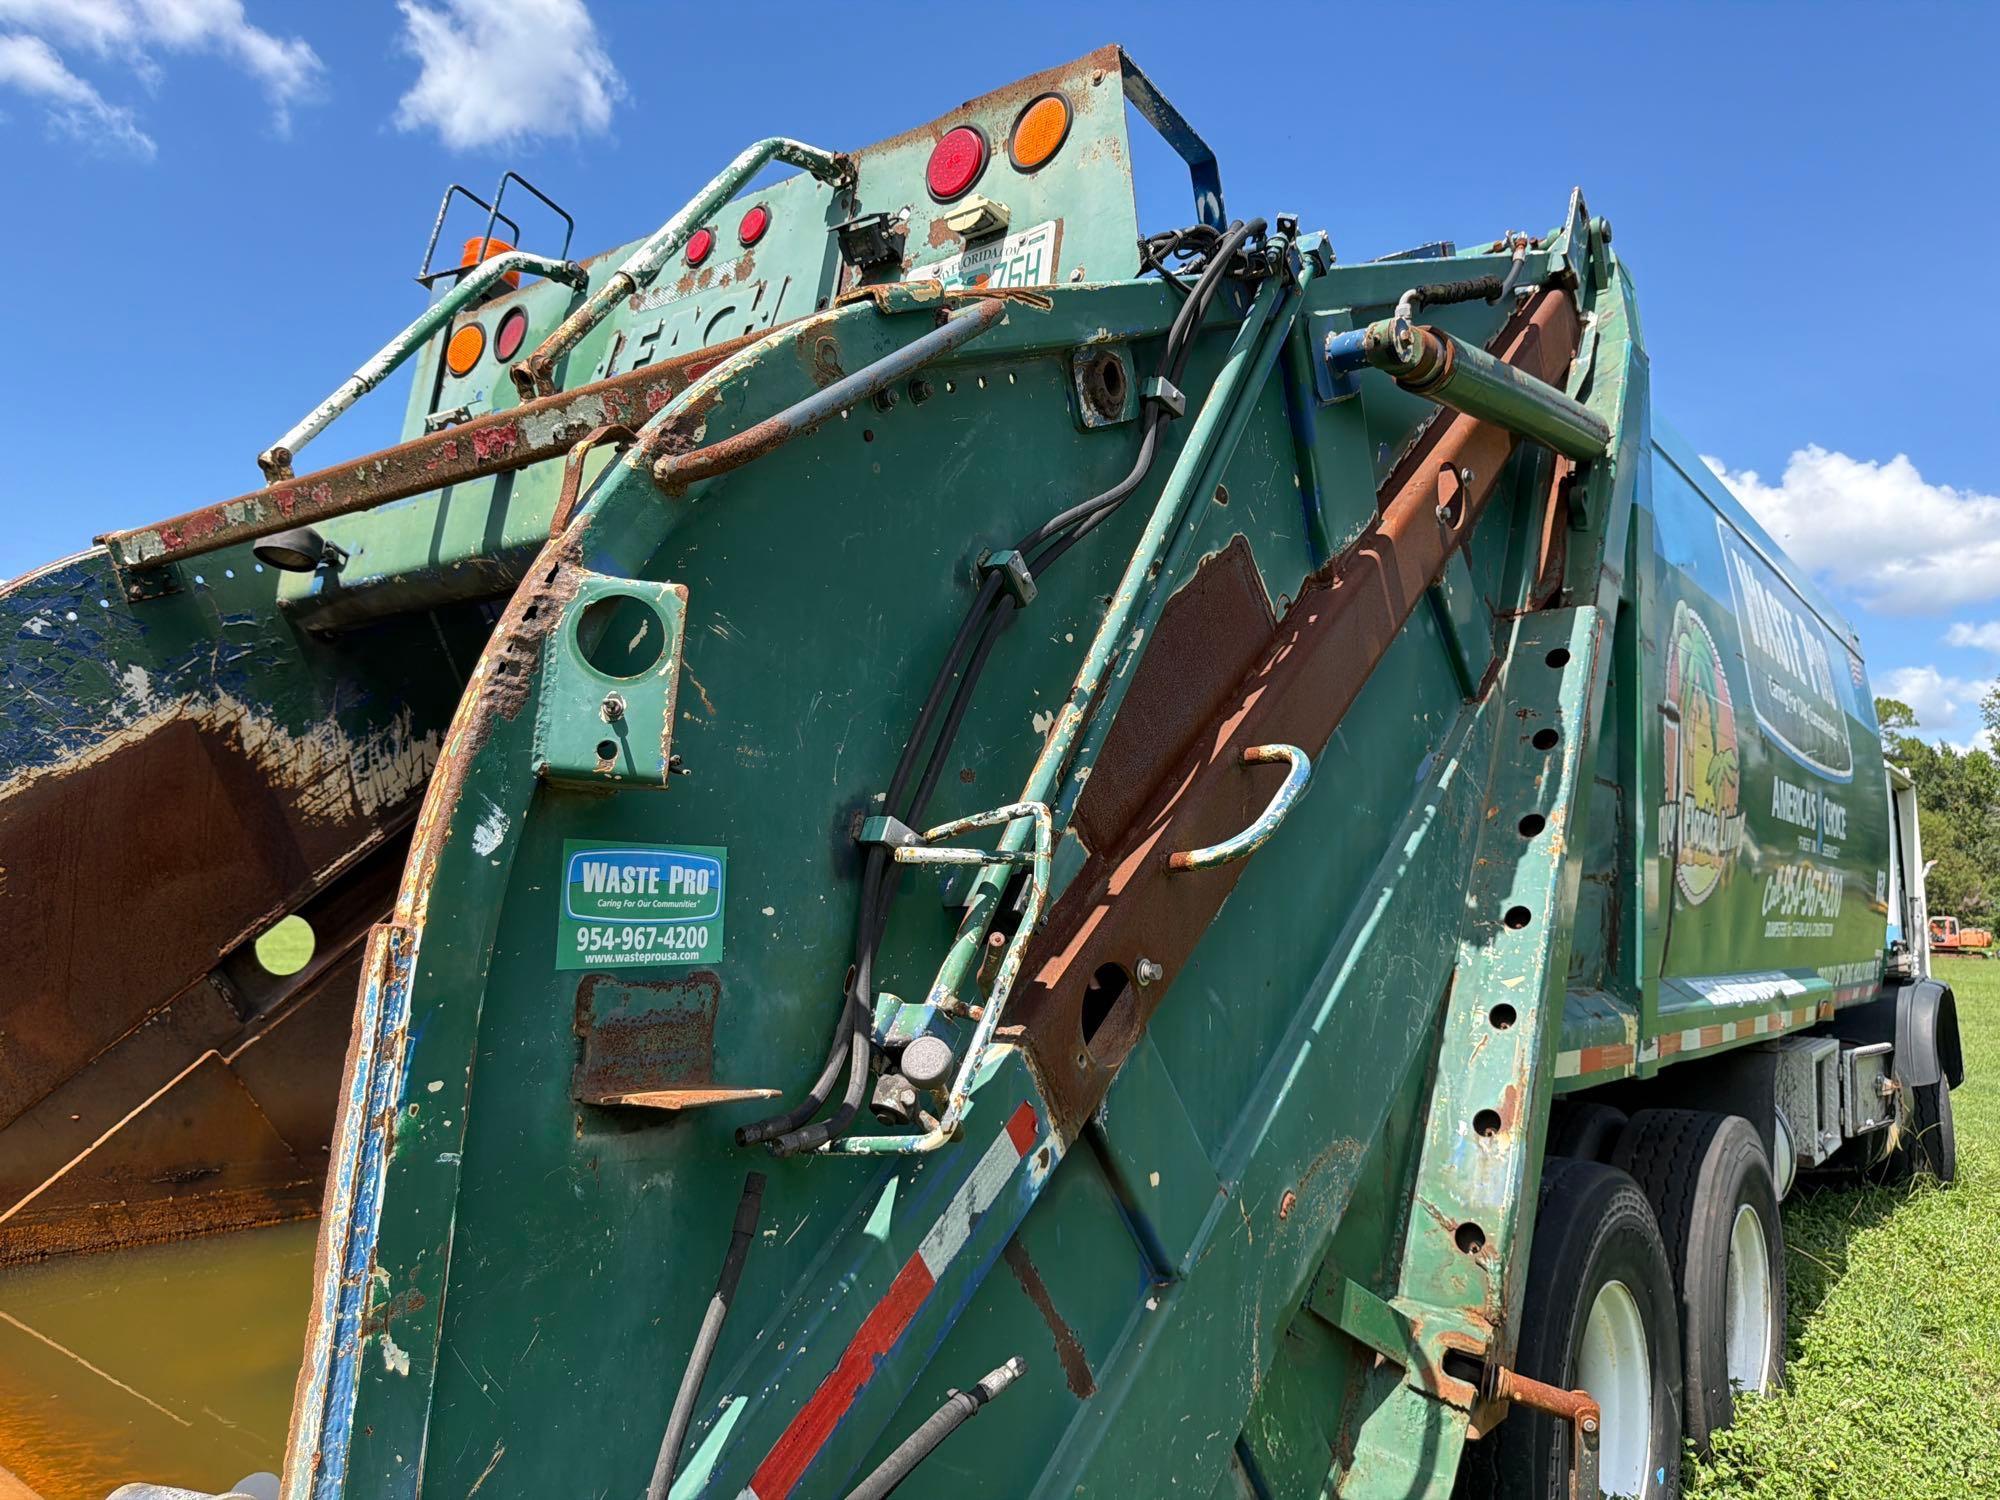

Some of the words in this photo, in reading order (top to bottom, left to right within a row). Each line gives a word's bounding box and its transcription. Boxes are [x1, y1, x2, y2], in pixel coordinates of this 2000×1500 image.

[1731, 548, 1807, 686] WASTE
[1796, 614, 1838, 711] PRO
[1822, 797, 1847, 841] CHOICE
[582, 861, 661, 894] WASTE
[668, 865, 710, 896] PRO
[597, 898, 622, 909] Caring
[623, 899, 636, 908] For
[637, 900, 651, 908] Our
[652, 900, 698, 908] Communities
[576, 926, 709, 952] 954-967-4200
[585, 951, 700, 965] www.wasteprousa.com
